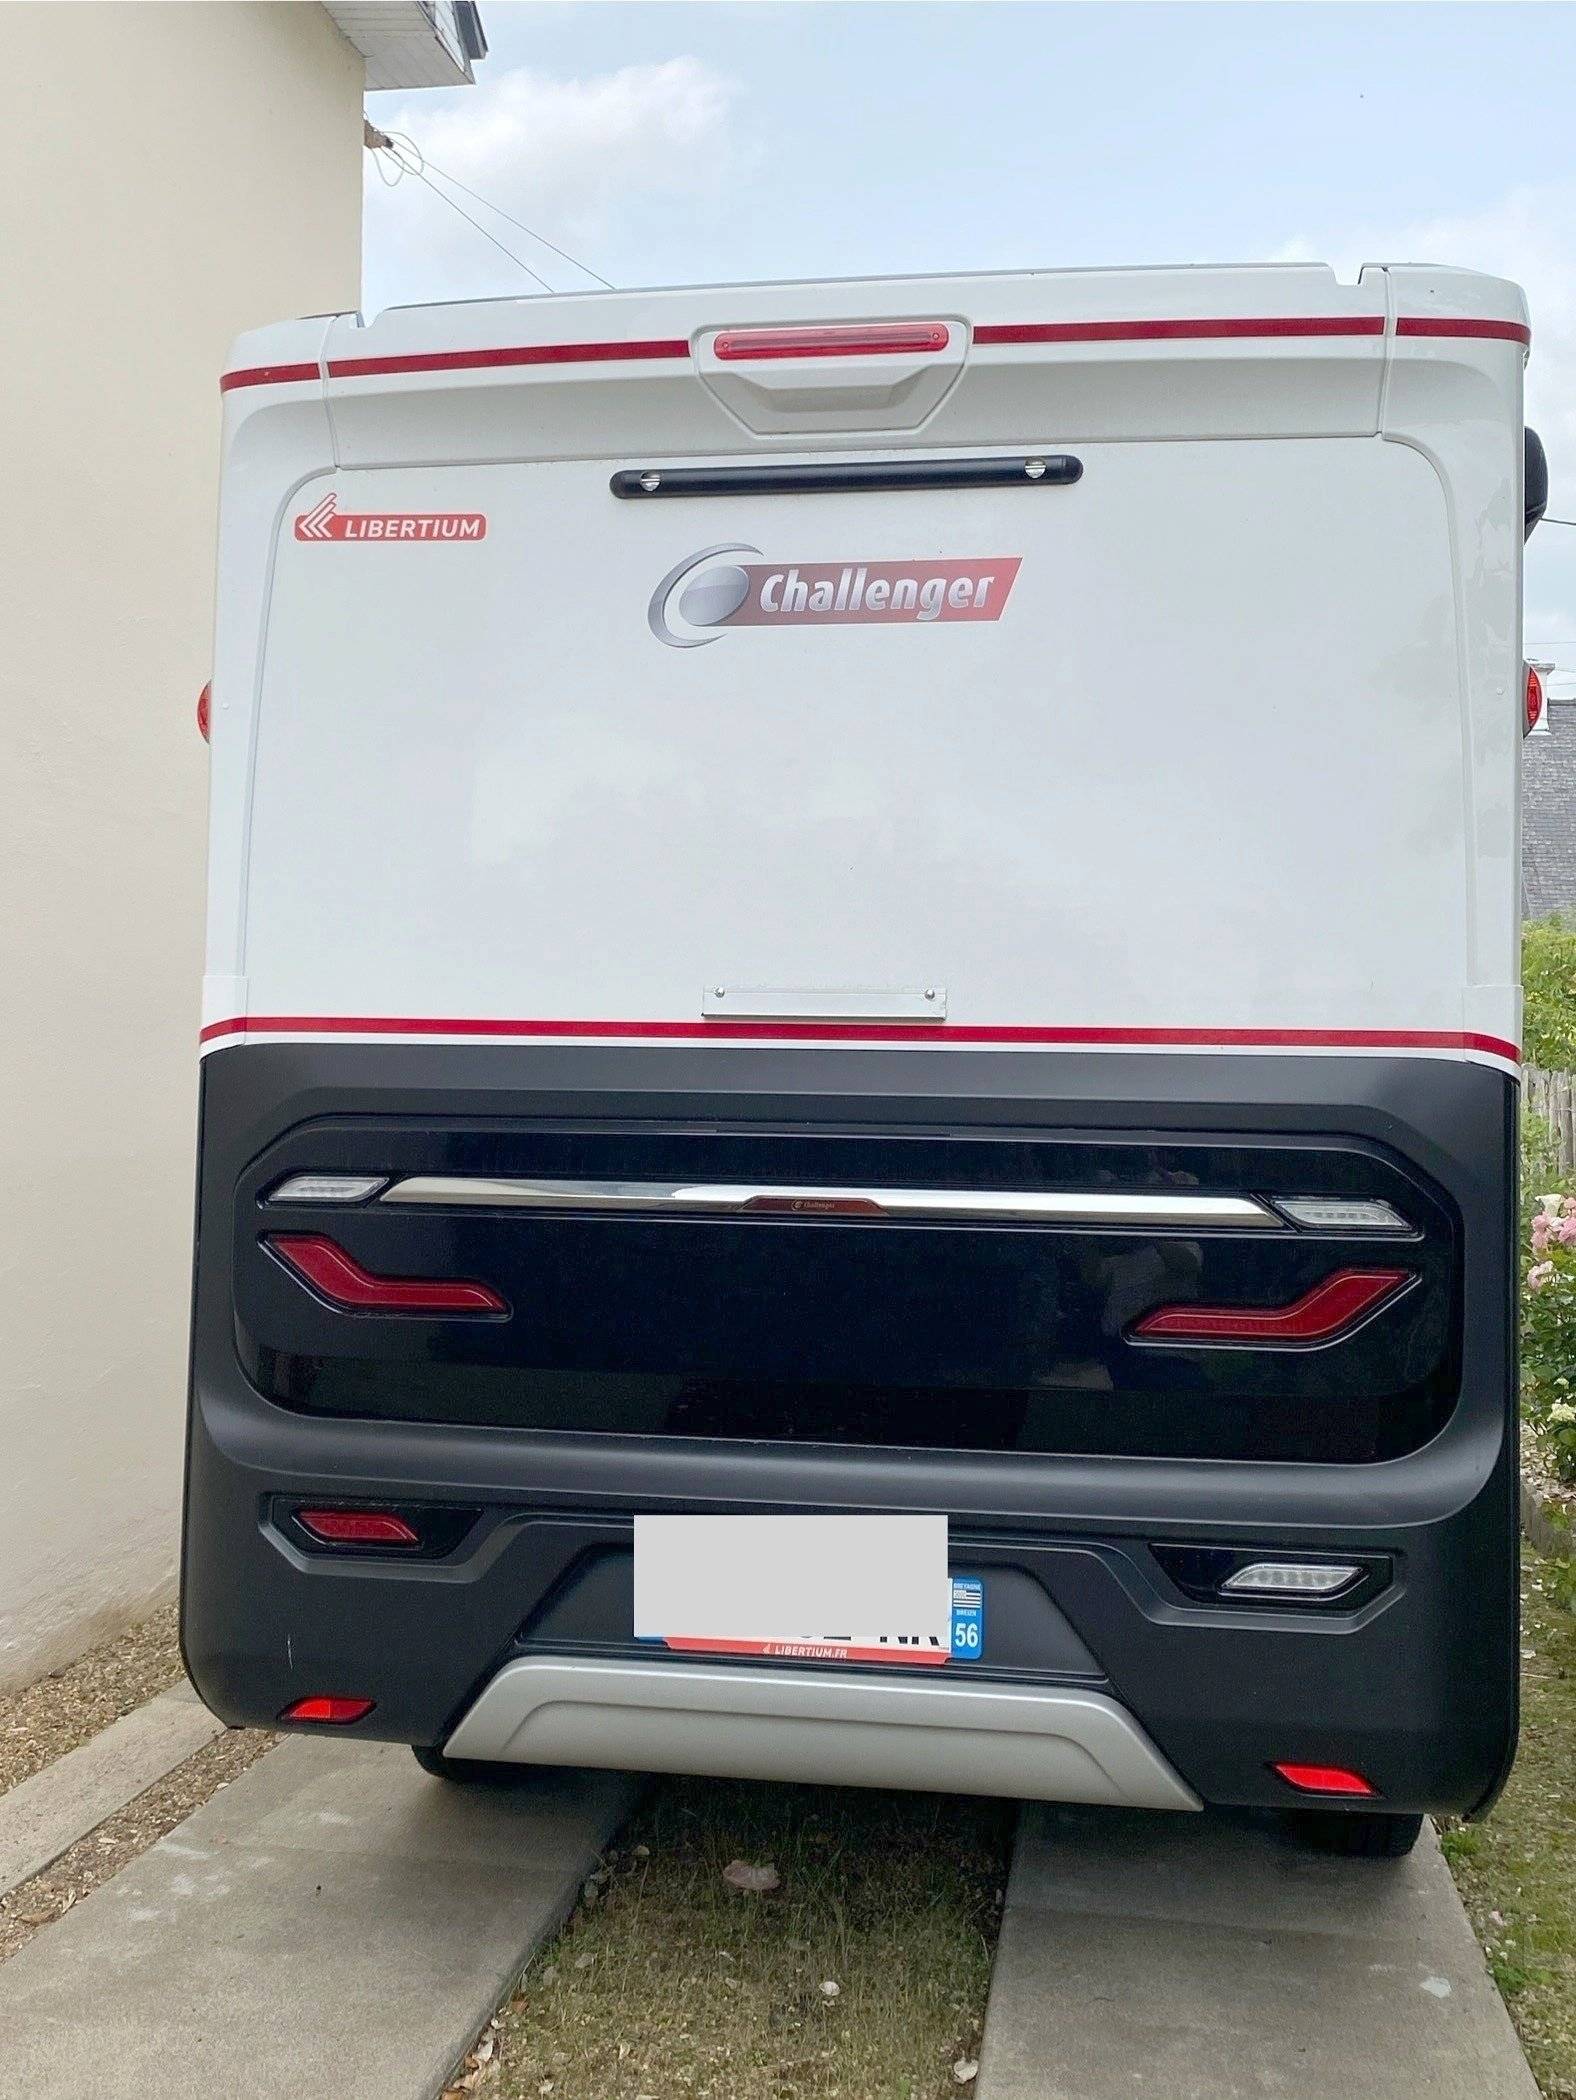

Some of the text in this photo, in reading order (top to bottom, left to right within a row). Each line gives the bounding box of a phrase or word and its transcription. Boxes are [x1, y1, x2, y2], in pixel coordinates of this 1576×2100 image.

[344, 519, 480, 538] LIBERTIUM
[760, 568, 995, 621] Challenger
[955, 1622, 979, 1648] 56
[774, 1645, 848, 1659] LIBERTIUM.FR
